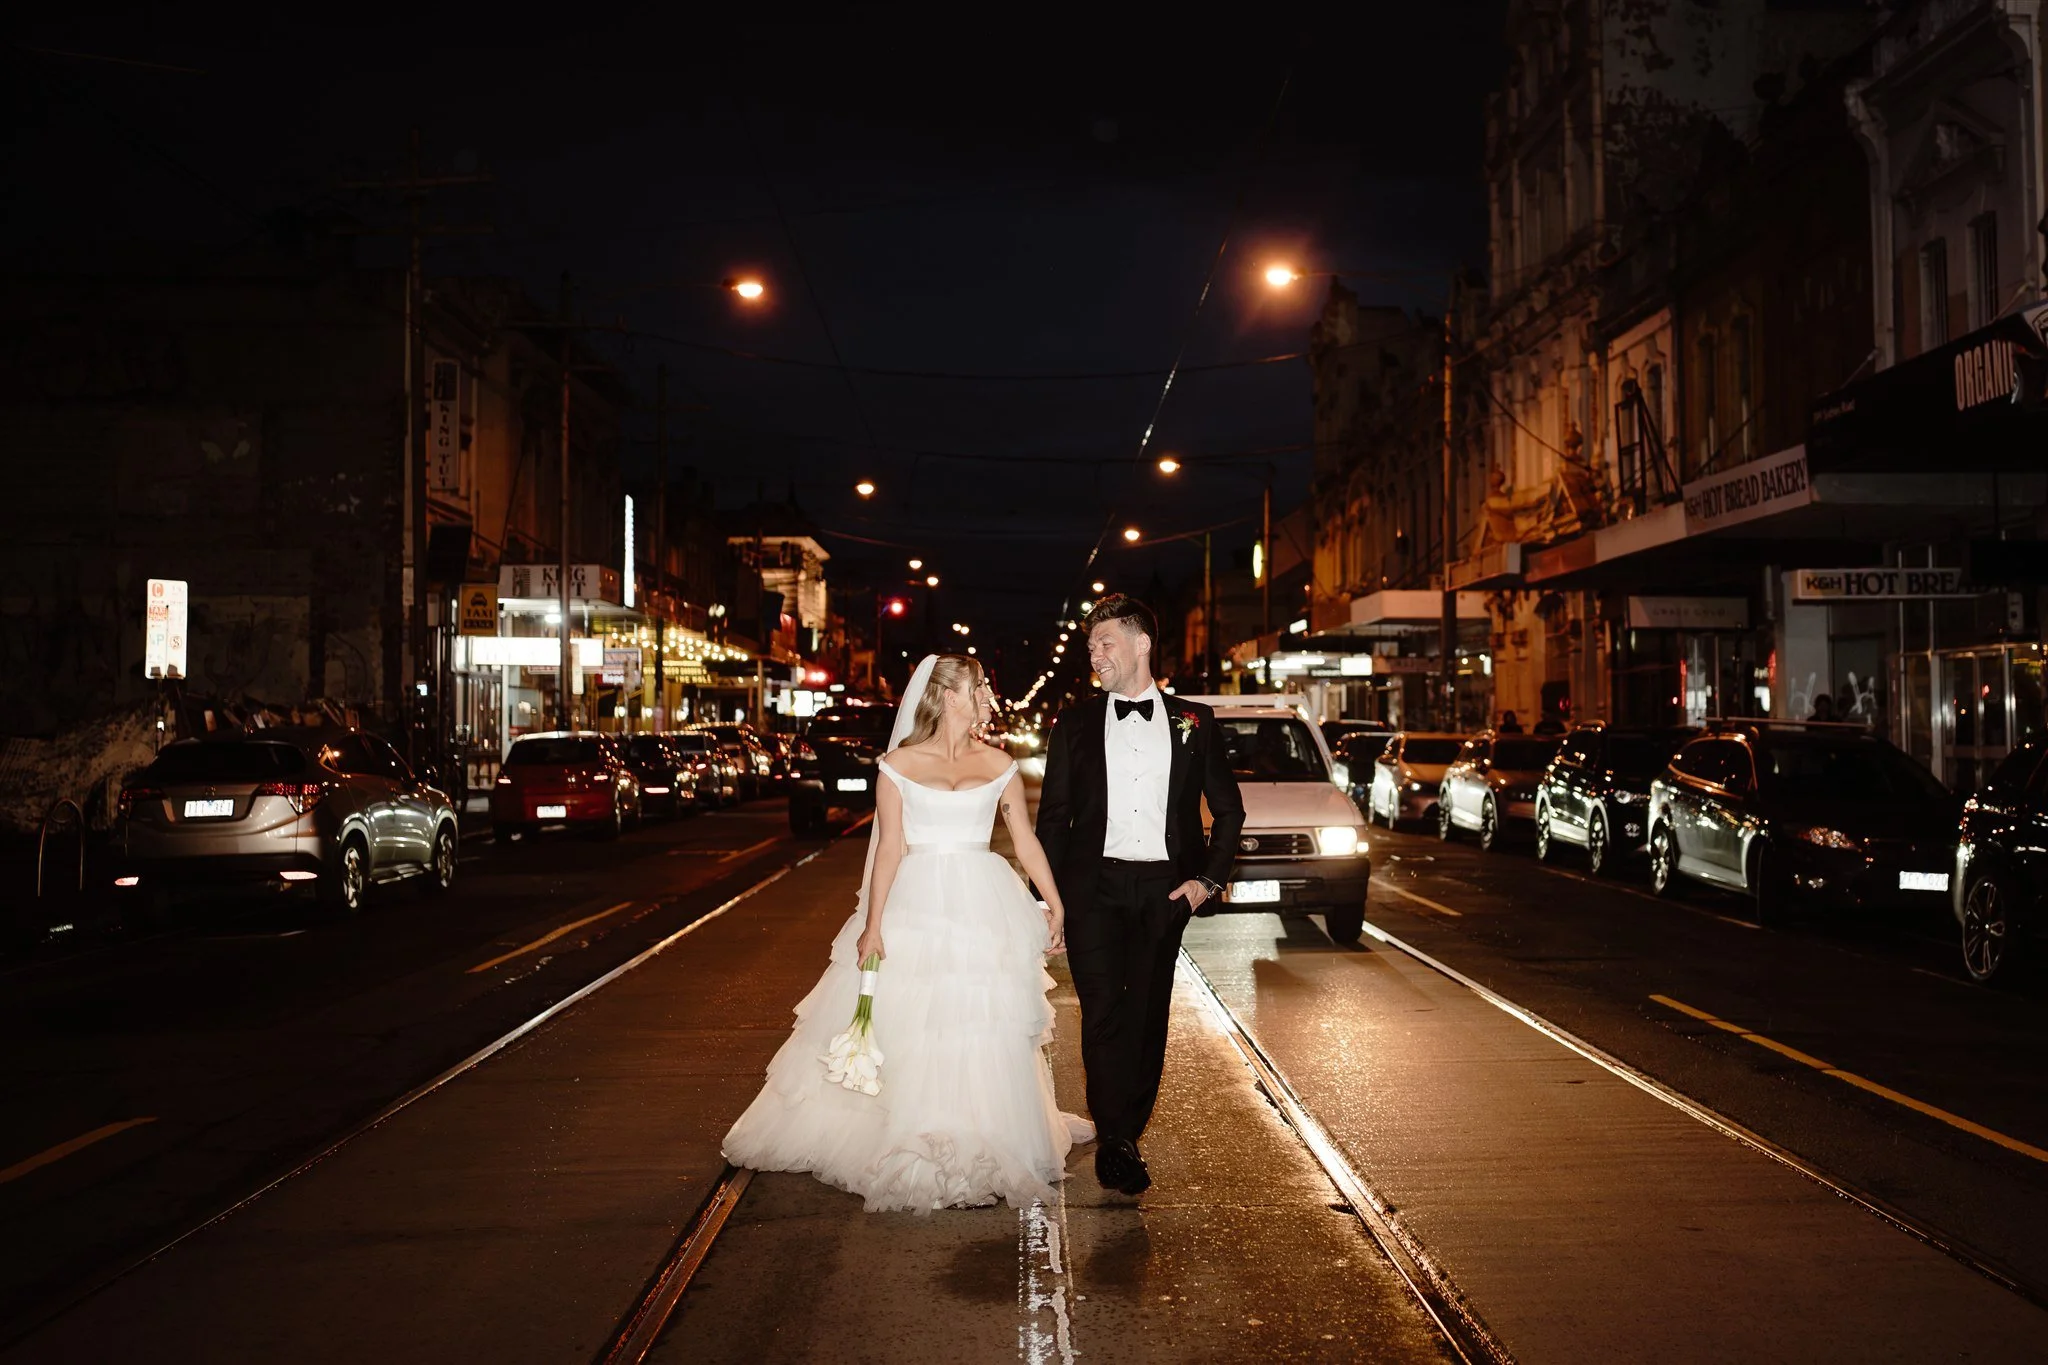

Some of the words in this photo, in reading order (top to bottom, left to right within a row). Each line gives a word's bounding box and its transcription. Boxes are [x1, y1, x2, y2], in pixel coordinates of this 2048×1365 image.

[439, 403, 450, 447] KING
[439, 453, 451, 487] TUT
[1702, 486, 1722, 519] HOT
[1724, 474, 1760, 513] BREAD
[1761, 458, 1806, 502] BAKERY
[542, 567, 586, 581] KIG
[1845, 572, 1898, 595] HOT
[542, 582, 586, 596] TT
[465, 608, 493, 618] TAXI
